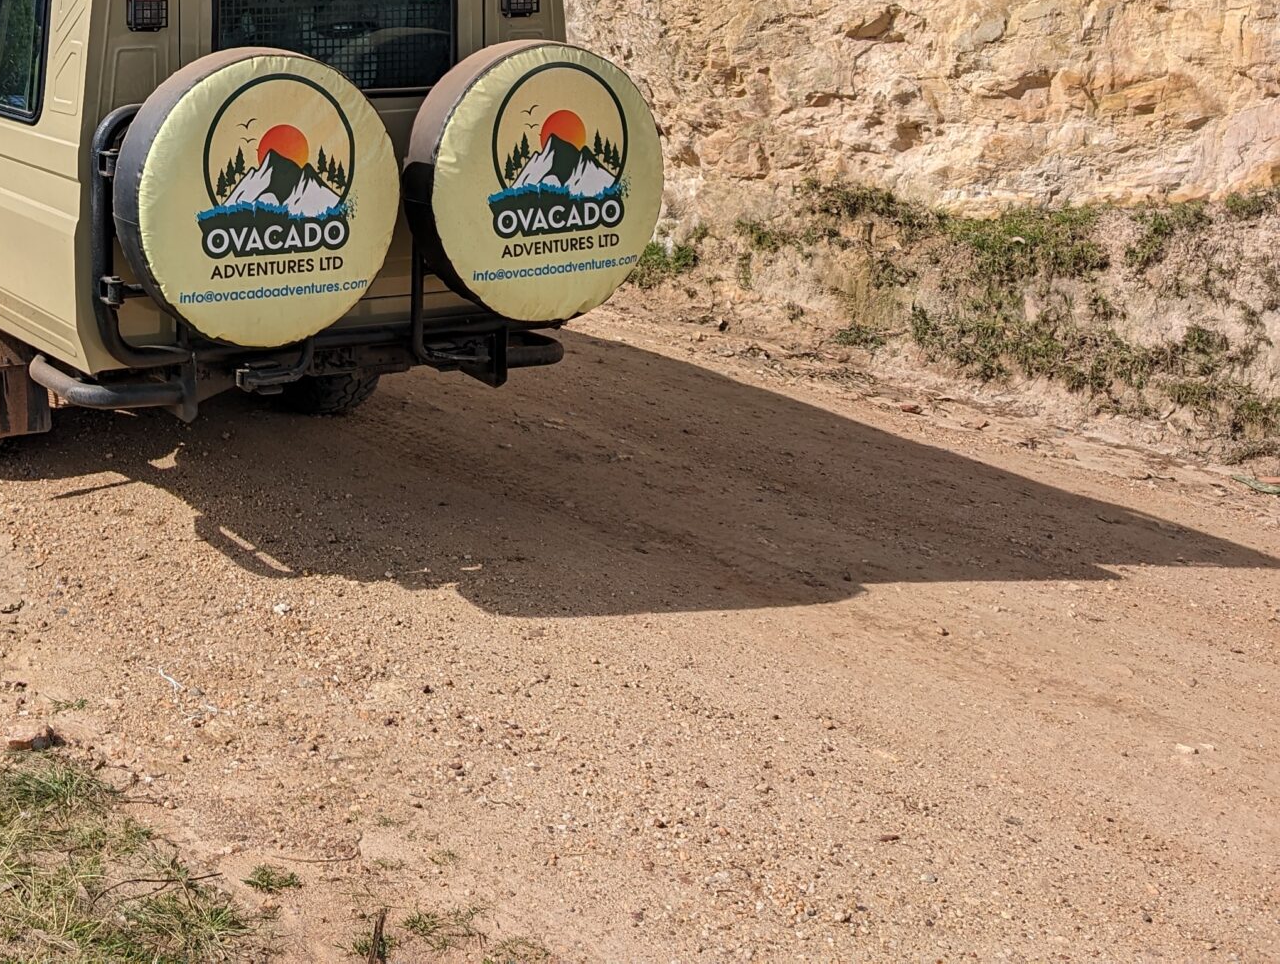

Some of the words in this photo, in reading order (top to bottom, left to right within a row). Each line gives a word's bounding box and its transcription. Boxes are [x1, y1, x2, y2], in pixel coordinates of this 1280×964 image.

[497, 199, 621, 233] OVACADO
[207, 220, 347, 254] OVACADO
[501, 236, 595, 258] ADVENTURES
[597, 233, 619, 248] LTD
[210, 257, 315, 280] ADVENTURES
[319, 256, 344, 272] LTD
[473, 254, 638, 282] info@ovacadoadventures.com
[179, 279, 368, 304] info@ovacadoadventures.com
